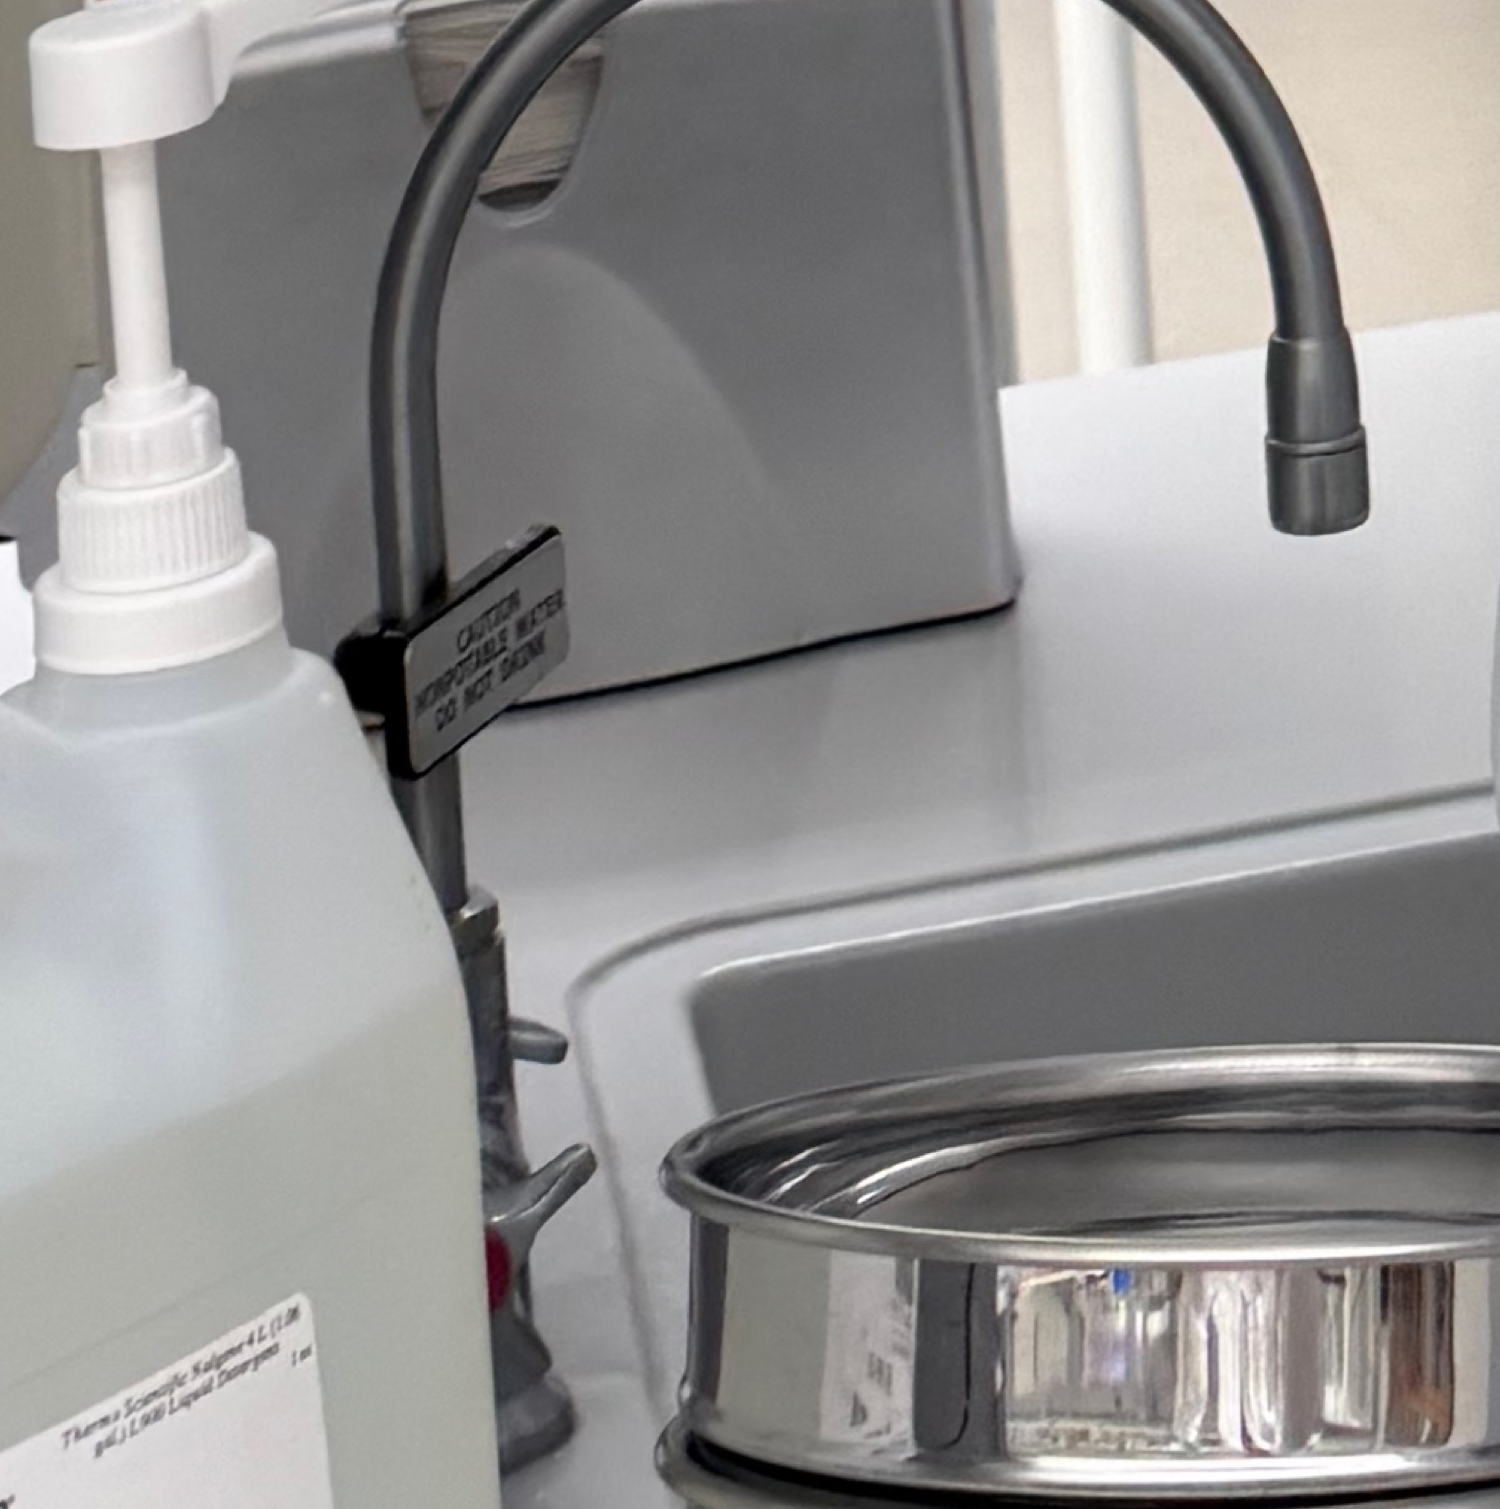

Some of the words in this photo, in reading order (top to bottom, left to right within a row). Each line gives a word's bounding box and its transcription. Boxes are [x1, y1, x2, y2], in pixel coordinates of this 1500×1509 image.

[457, 588, 521, 654] CAUTION
[435, 699, 456, 732] DO
[464, 668, 493, 710] NOT
